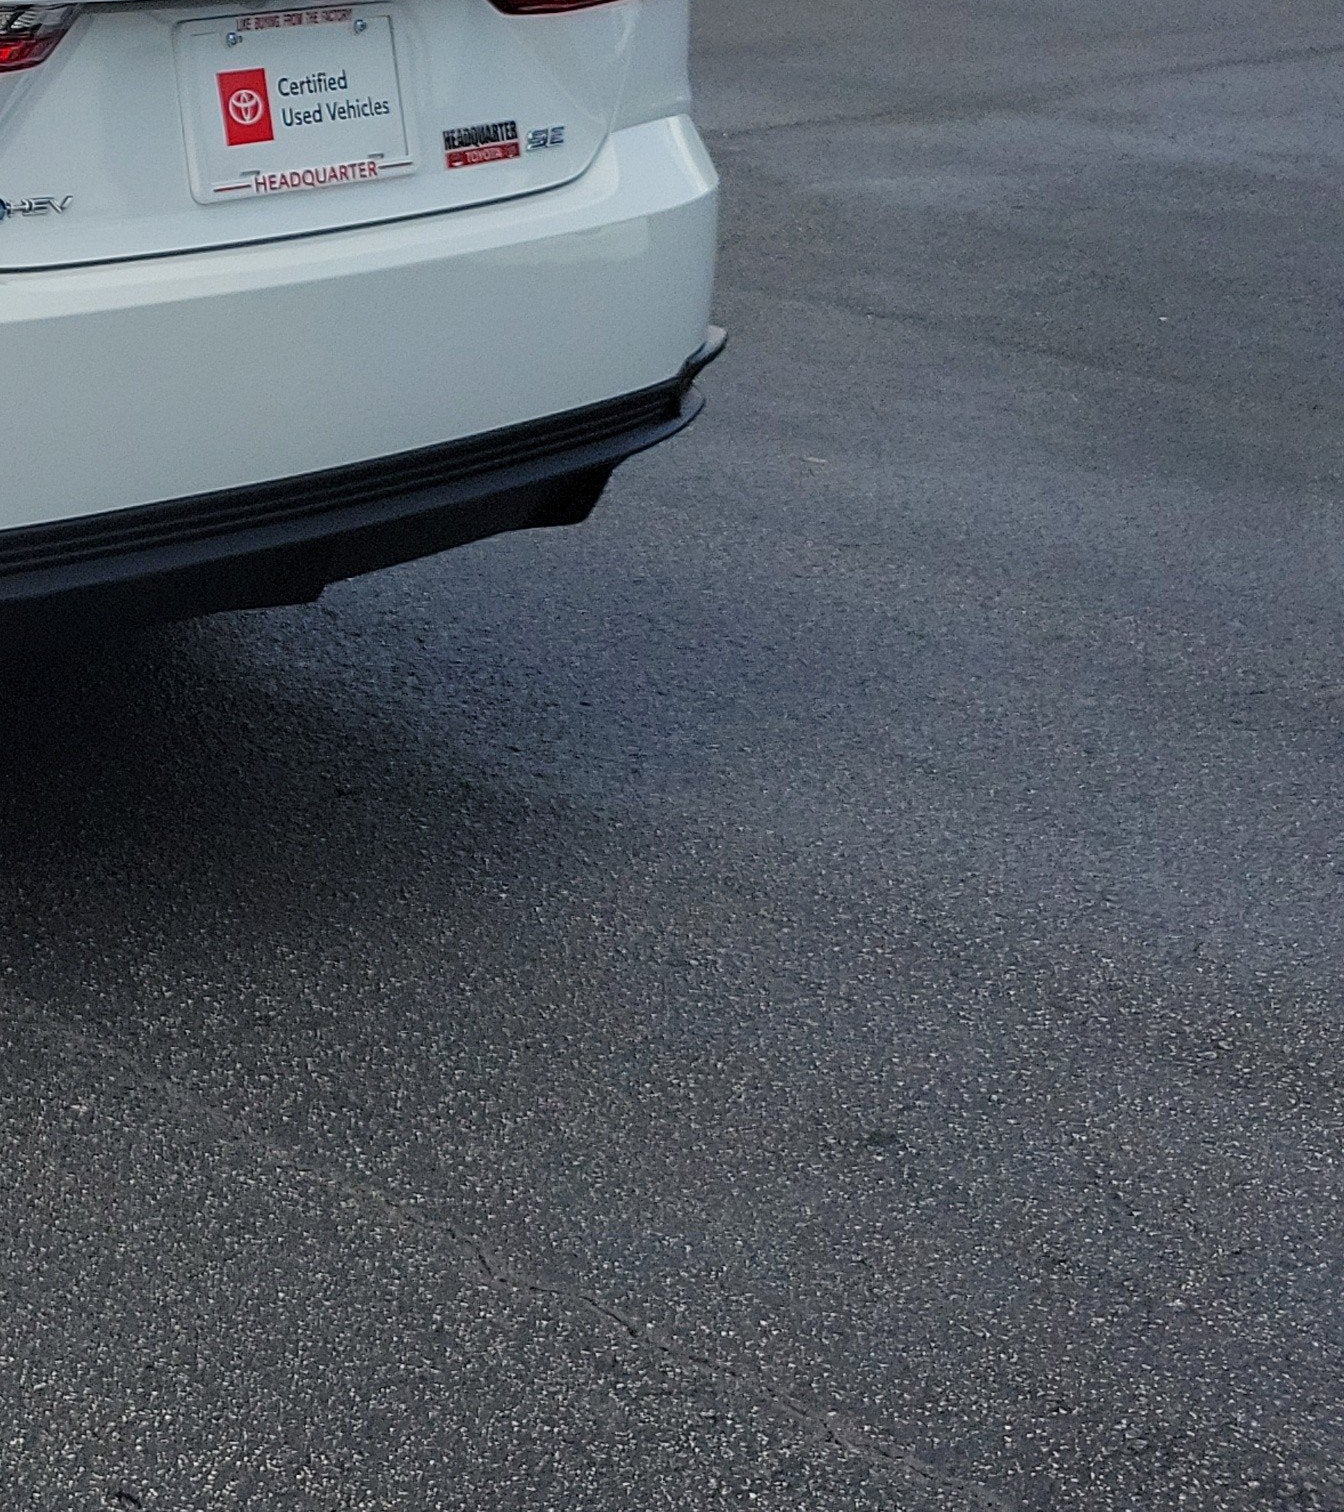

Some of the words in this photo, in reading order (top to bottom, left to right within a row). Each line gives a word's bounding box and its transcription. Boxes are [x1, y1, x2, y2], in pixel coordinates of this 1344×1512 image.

[236, 17, 251, 32] LIKE
[283, 12, 303, 27] FROM
[305, 11, 319, 24] THE
[321, 8, 352, 22] FACTORY
[278, 69, 348, 97] Certified
[282, 103, 323, 127] Used
[326, 96, 390, 121] Vehicles
[442, 120, 518, 150] HEADQUARTER
[526, 126, 565, 152] SE
[466, 148, 503, 163] TOYOTA
[254, 161, 378, 193] HEADQUARTER
